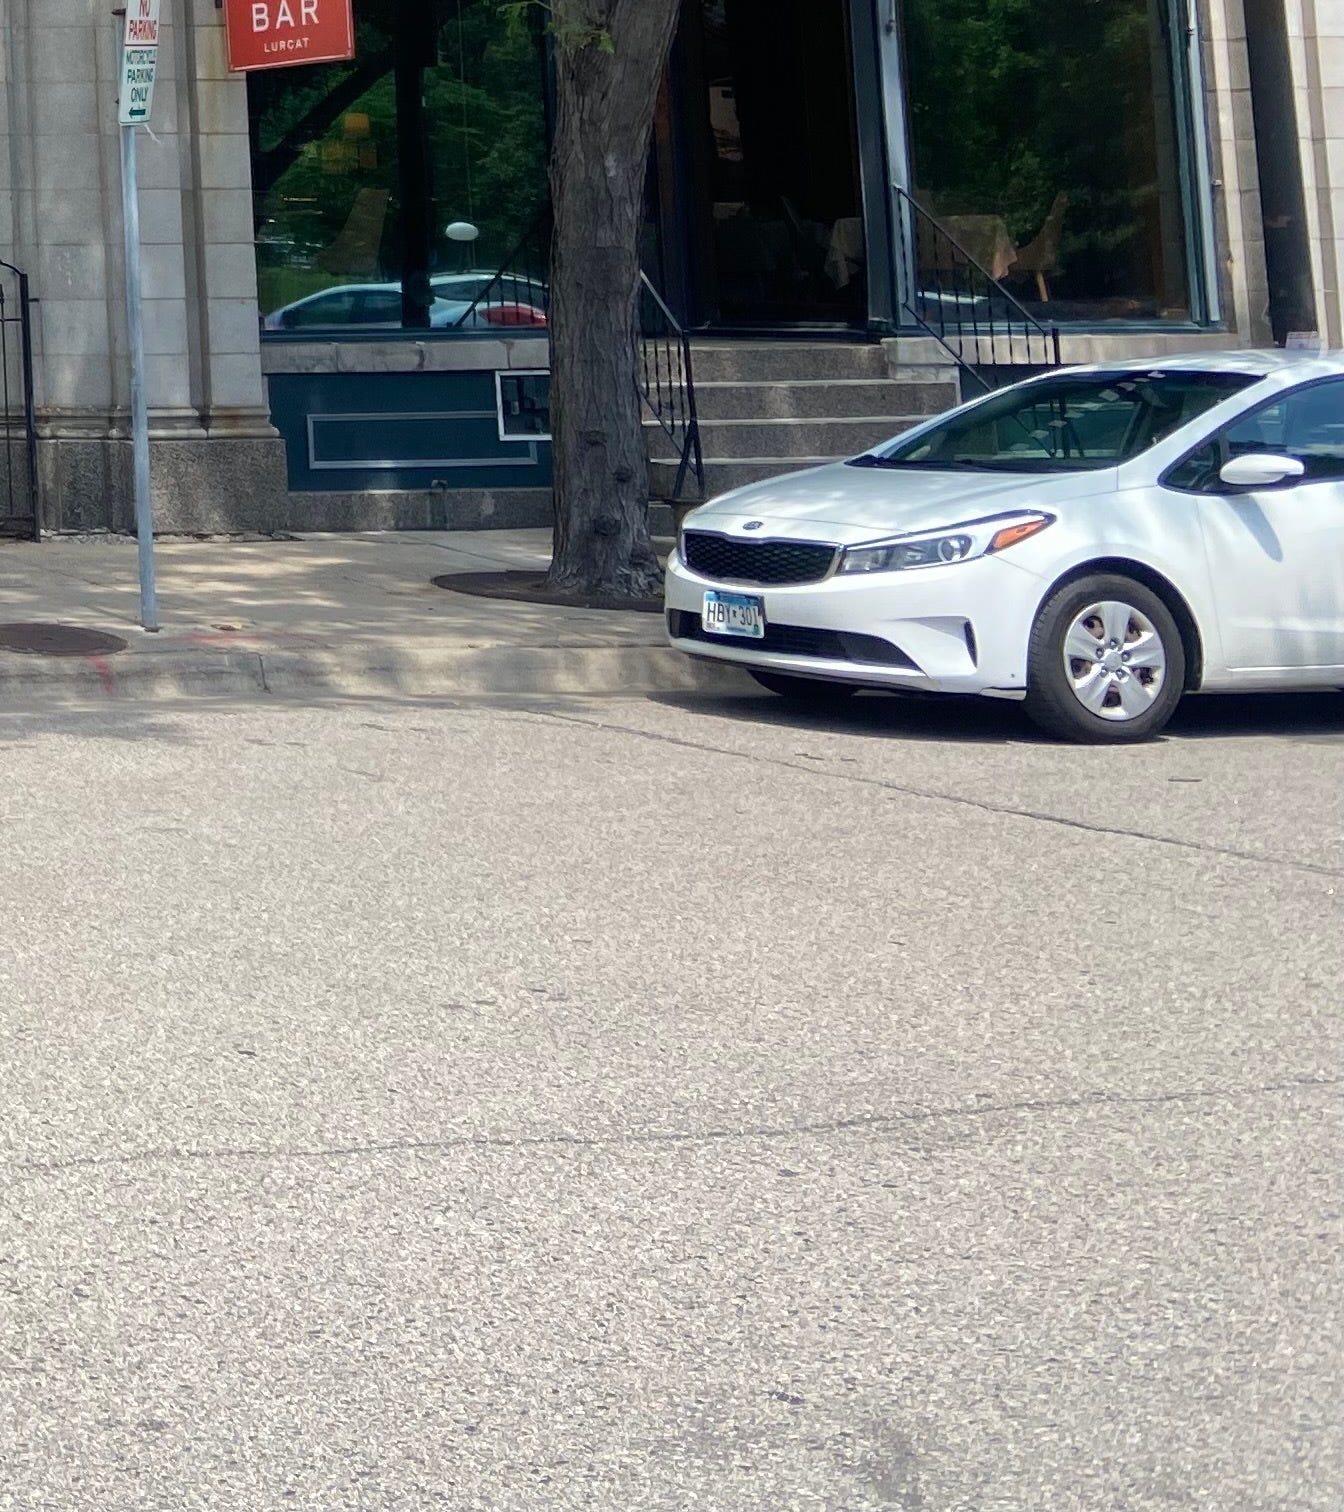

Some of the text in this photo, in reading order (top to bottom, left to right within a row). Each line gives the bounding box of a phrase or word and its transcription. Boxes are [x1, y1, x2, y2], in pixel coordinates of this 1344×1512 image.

[128, 19, 157, 40] PARKING
[127, 68, 154, 85] PARKING
[130, 87, 149, 103] ONLY
